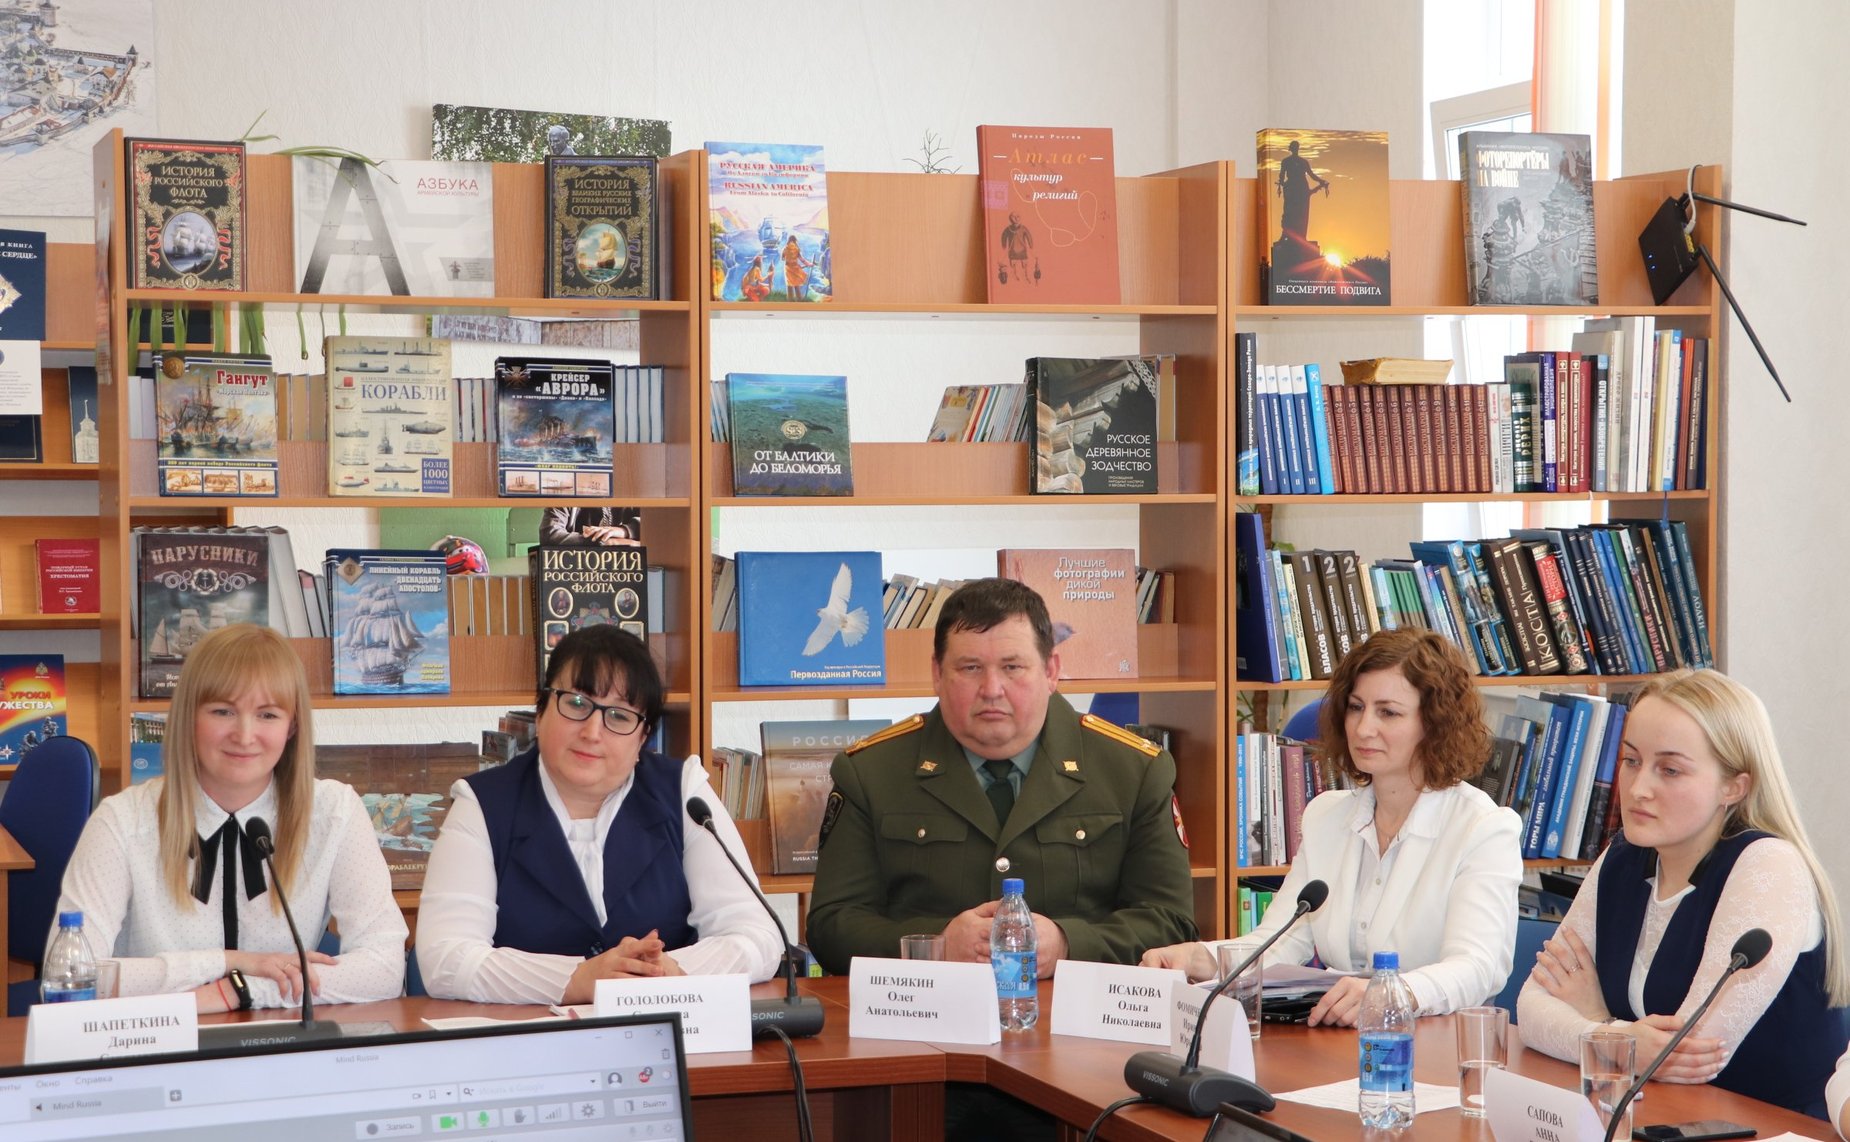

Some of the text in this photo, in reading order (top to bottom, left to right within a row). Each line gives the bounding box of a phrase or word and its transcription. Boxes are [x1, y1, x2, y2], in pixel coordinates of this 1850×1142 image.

[1008, 148, 1087, 165] Атлас
[1476, 150, 1549, 170] ФОТОРЕПОРТЁРЫ
[162, 166, 215, 177] ИСТОРИЯ
[720, 161, 816, 172] РУССКАЯ АМЕРИКА
[154, 176, 223, 187] РОССИЙСКОГО
[417, 177, 479, 190] АЗБУКА
[574, 178, 630, 189] ИСТОРИЯ
[1014, 172, 1063, 183] культур
[1477, 170, 1489, 187] НА
[1491, 169, 1519, 188] ВОЙНЕ
[169, 187, 208, 198] ФЛОТА
[724, 182, 813, 191] RUSSIAN AMERICA
[1032, 190, 1078, 202] религий
[571, 204, 632, 215] ОТКРЫТИЙ
[7, 241, 33, 249] КНИГА
[1276, 285, 1382, 296] БЕССМЕРТИЕ ПОДВИГА
[216, 370, 268, 388] Гангут
[551, 373, 590, 383] КРЕЙСЕР
[361, 384, 447, 400] КОРАБЛИ
[535, 382, 605, 396] «АВРОРА»
[1598, 380, 1607, 471] ОТКРЫТИЯ ИЗОБРЕТЕНИЯ
[1106, 434, 1151, 445] РУССКОЕ
[1520, 417, 1531, 456] РЕРИХ
[754, 450, 835, 462] ОТ БАЛТИКИ
[1085, 448, 1151, 458] ДЕРЕВЯННОЕ
[423, 461, 449, 469] БОЛЕЕ
[750, 463, 841, 474] ДО БЕЛОМОРЬЯ
[1091, 461, 1151, 472] ЗОДЧЕСТВО
[424, 469, 449, 478] 1000
[150, 545, 259, 567] ПАРУСНИКИ
[543, 550, 643, 571] ИСТОРИЯ
[1058, 557, 1106, 570] Лучшие
[1302, 555, 1311, 573] 1
[1324, 556, 1336, 575] 2
[1343, 556, 1356, 574] 2
[369, 566, 441, 575] ЛИНЕЙНЫЙ КОРАБЛЬ
[544, 570, 644, 583] РОССИЙСКОГО
[1054, 567, 1125, 580] фотографии
[1511, 552, 1527, 590] Произведения
[1546, 560, 1560, 595] ИСТОРИЯ
[571, 582, 616, 594] ФЛОТА
[1066, 579, 1101, 591] дикой
[1063, 591, 1115, 601] природы
[1690, 594, 1706, 629] ЛОДКИ
[1340, 634, 1350, 653] СОВ
[1644, 613, 1665, 667] ПАРУСНИКИ
[1317, 633, 1331, 673] ВЛАСОВ
[790, 669, 882, 680] Первозданная Россия
[10, 691, 51, 700] УРОКИ
[0, 701, 54, 710] УЖЕСТВА
[789, 762, 823, 770] САМАЯ
[1554, 798, 1564, 822] АКАДЕМИЯ
[1559, 764, 1572, 798] ГРАЖДАНСКОЙ
[1567, 743, 1577, 764] ЗАЩИТЫ.
[1575, 710, 1584, 731] ИСТОРИИ
[1529, 720, 1563, 849] ГОРЫ МИРА глобальный приоритет
[870, 975, 934, 988] ШЕМЯКИН
[888, 991, 915, 1003] Олег
[1108, 983, 1162, 999] ИСАКОВА
[616, 993, 704, 1006] ГОЛОЛОБОВА
[865, 1005, 938, 1019] Анатольевич
[1118, 1000, 1149, 1013] Ольга
[752, 1011, 785, 1021] SONIC
[1102, 1014, 1162, 1030] Николаевна
[83, 1015, 180, 1035] ШАПЕТКИНА
[108, 1034, 156, 1049] Дарина
[240, 1036, 297, 1046] VISSONIC
[336, 1052, 379, 1064] Mind Russia
[36, 1074, 113, 1088] Окно Справка
[1142, 1070, 1170, 1087] VISSONIC
[53, 1098, 102, 1111] Mind Russia
[1527, 1104, 1564, 1128] САПОВА
[385, 1121, 415, 1131] Запись
[1535, 1127, 1560, 1142] АННА
